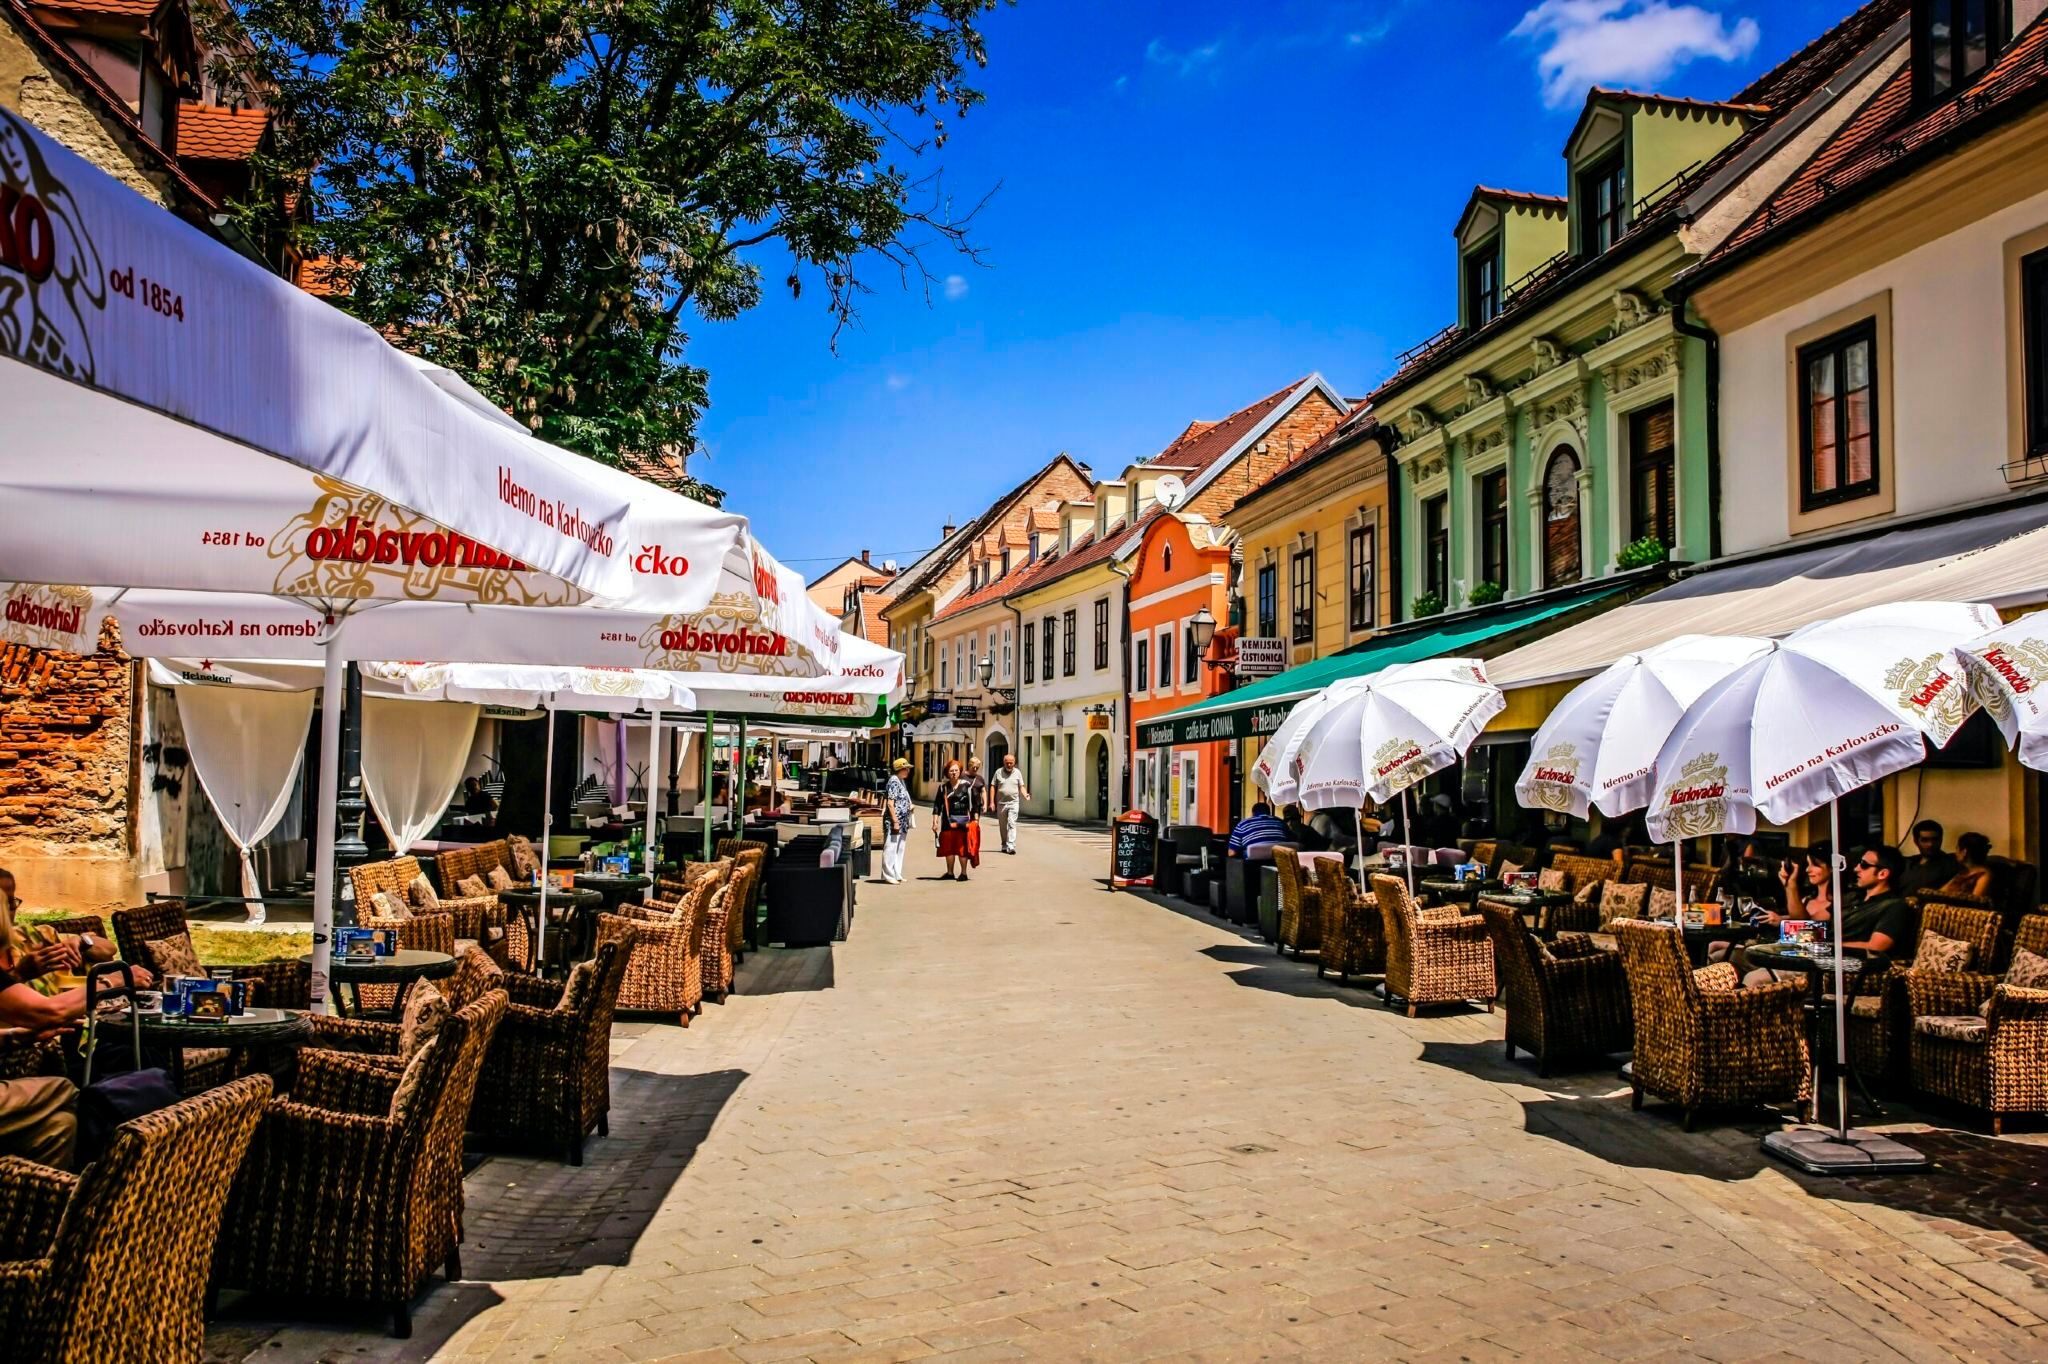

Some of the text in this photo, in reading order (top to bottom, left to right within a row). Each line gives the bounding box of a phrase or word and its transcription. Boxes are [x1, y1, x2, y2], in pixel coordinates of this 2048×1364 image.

[110, 266, 184, 322] od 1854
[499, 466, 536, 517] Idemo
[539, 499, 554, 528] na
[629, 545, 689, 577] čko
[1242, 640, 1283, 650] KEMIJSKA
[1242, 651, 1283, 662] ČISTIONICA
[182, 671, 233, 684] Heineken
[1982, 648, 2031, 694] Karlovačko
[1151, 725, 1173, 744] Heineken
[1186, 721, 1199, 740] caffe
[1200, 719, 1209, 738] bar
[1210, 715, 1234, 738] DONNA
[1378, 747, 1422, 777] Karlovačko
[1765, 722, 1900, 790] Idemo na Karlovačko
[1535, 767, 1575, 784] Karlovačko
[1603, 772, 1634, 790] Idemo
[1636, 767, 1648, 778] na
[1669, 782, 1725, 805] Karlovačko
